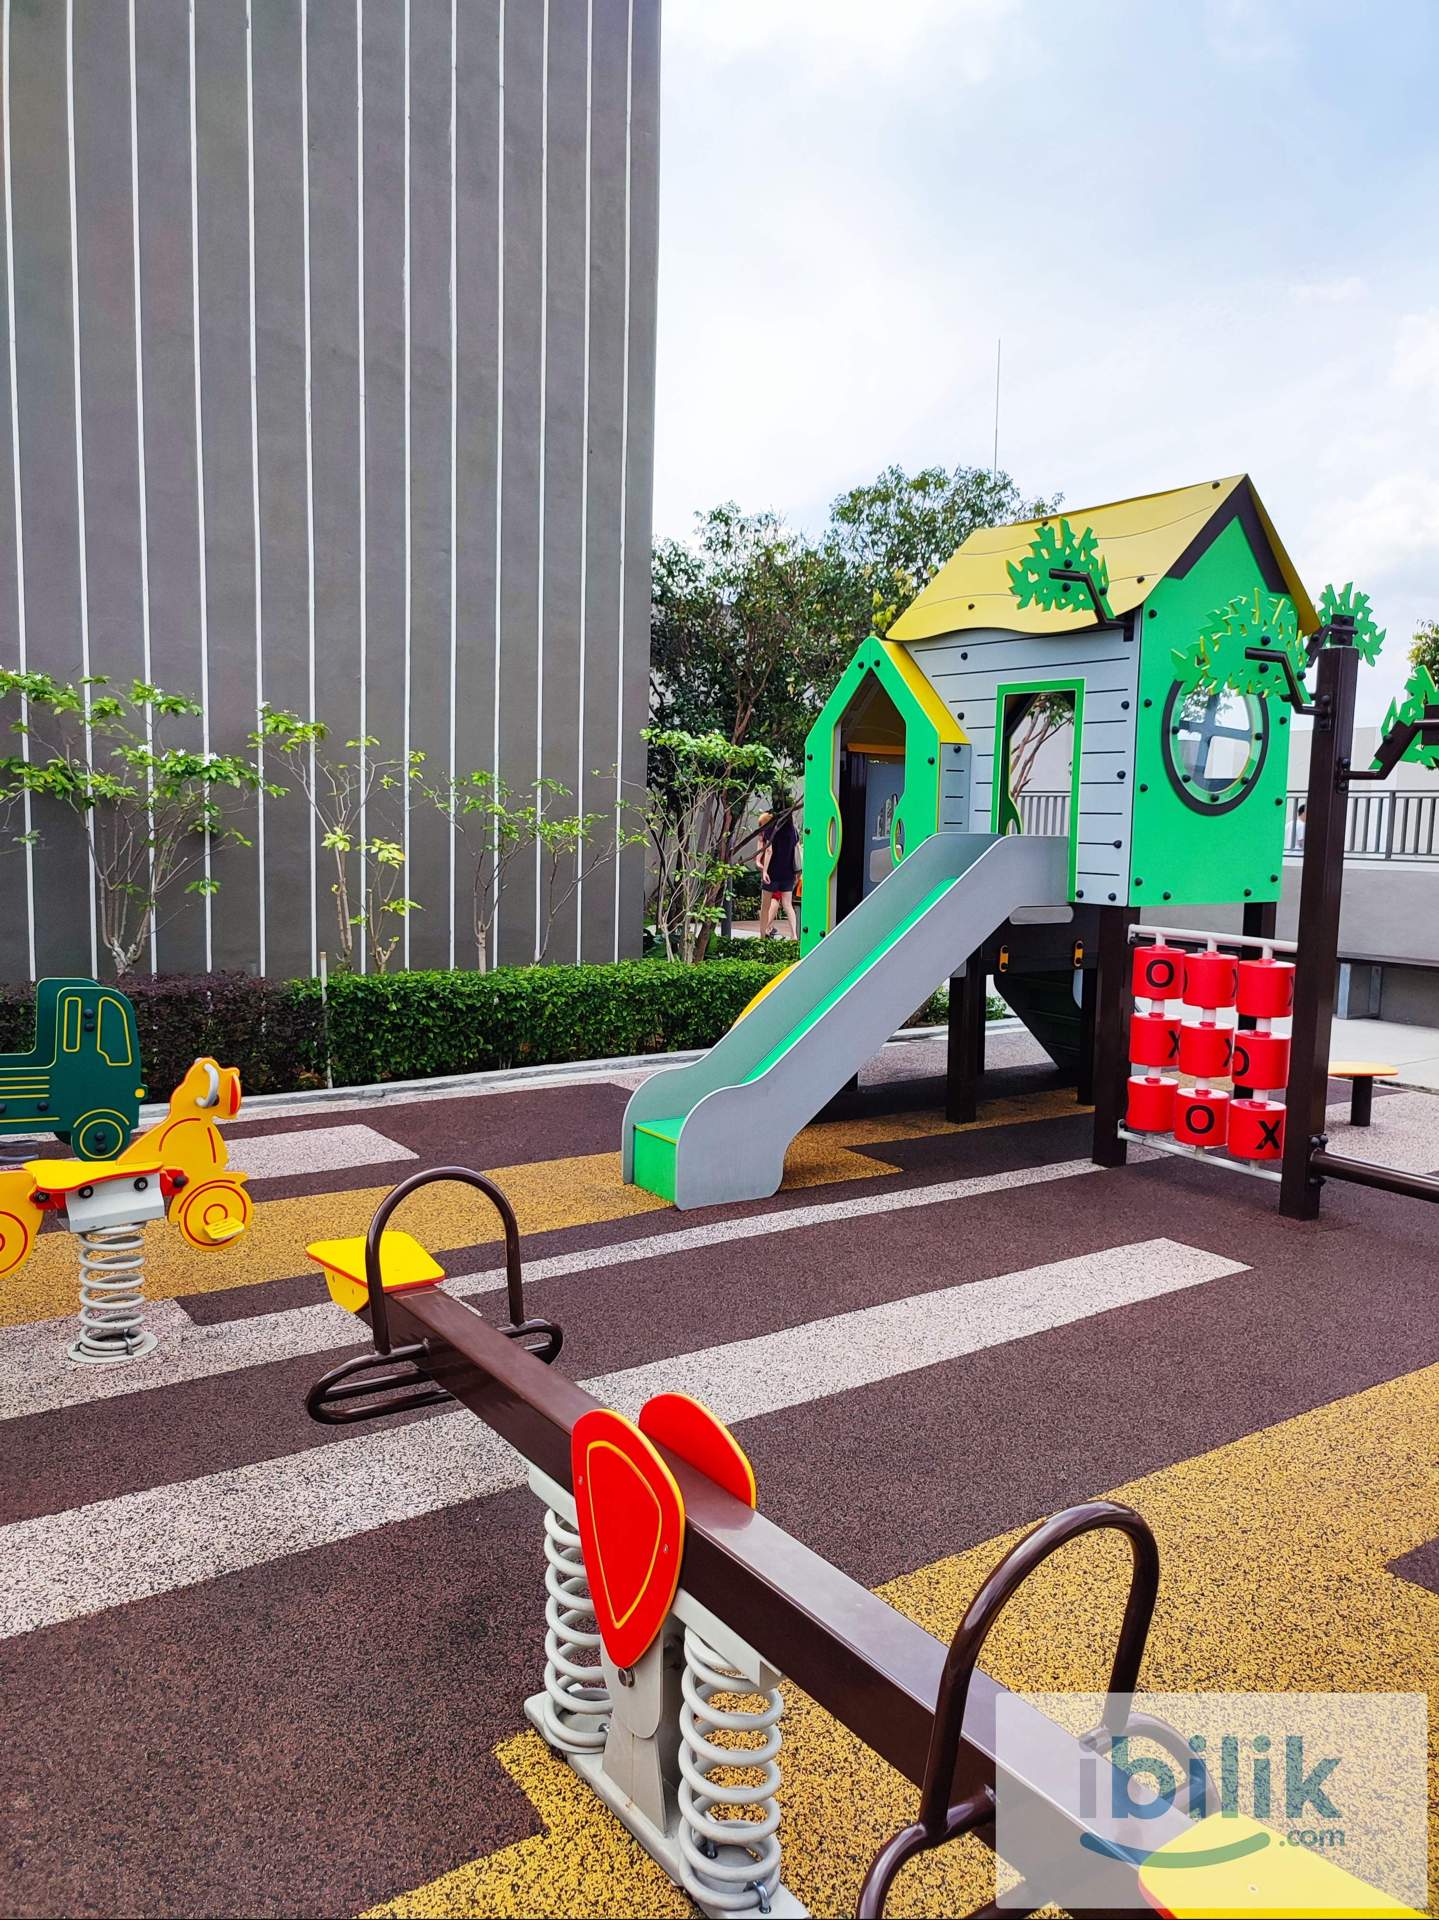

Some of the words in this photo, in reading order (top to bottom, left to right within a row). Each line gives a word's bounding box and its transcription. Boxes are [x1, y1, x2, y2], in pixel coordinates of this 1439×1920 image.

[1146, 959, 1175, 988] O
[1185, 1105, 1215, 1134] O
[1256, 1120, 1282, 1149] X
